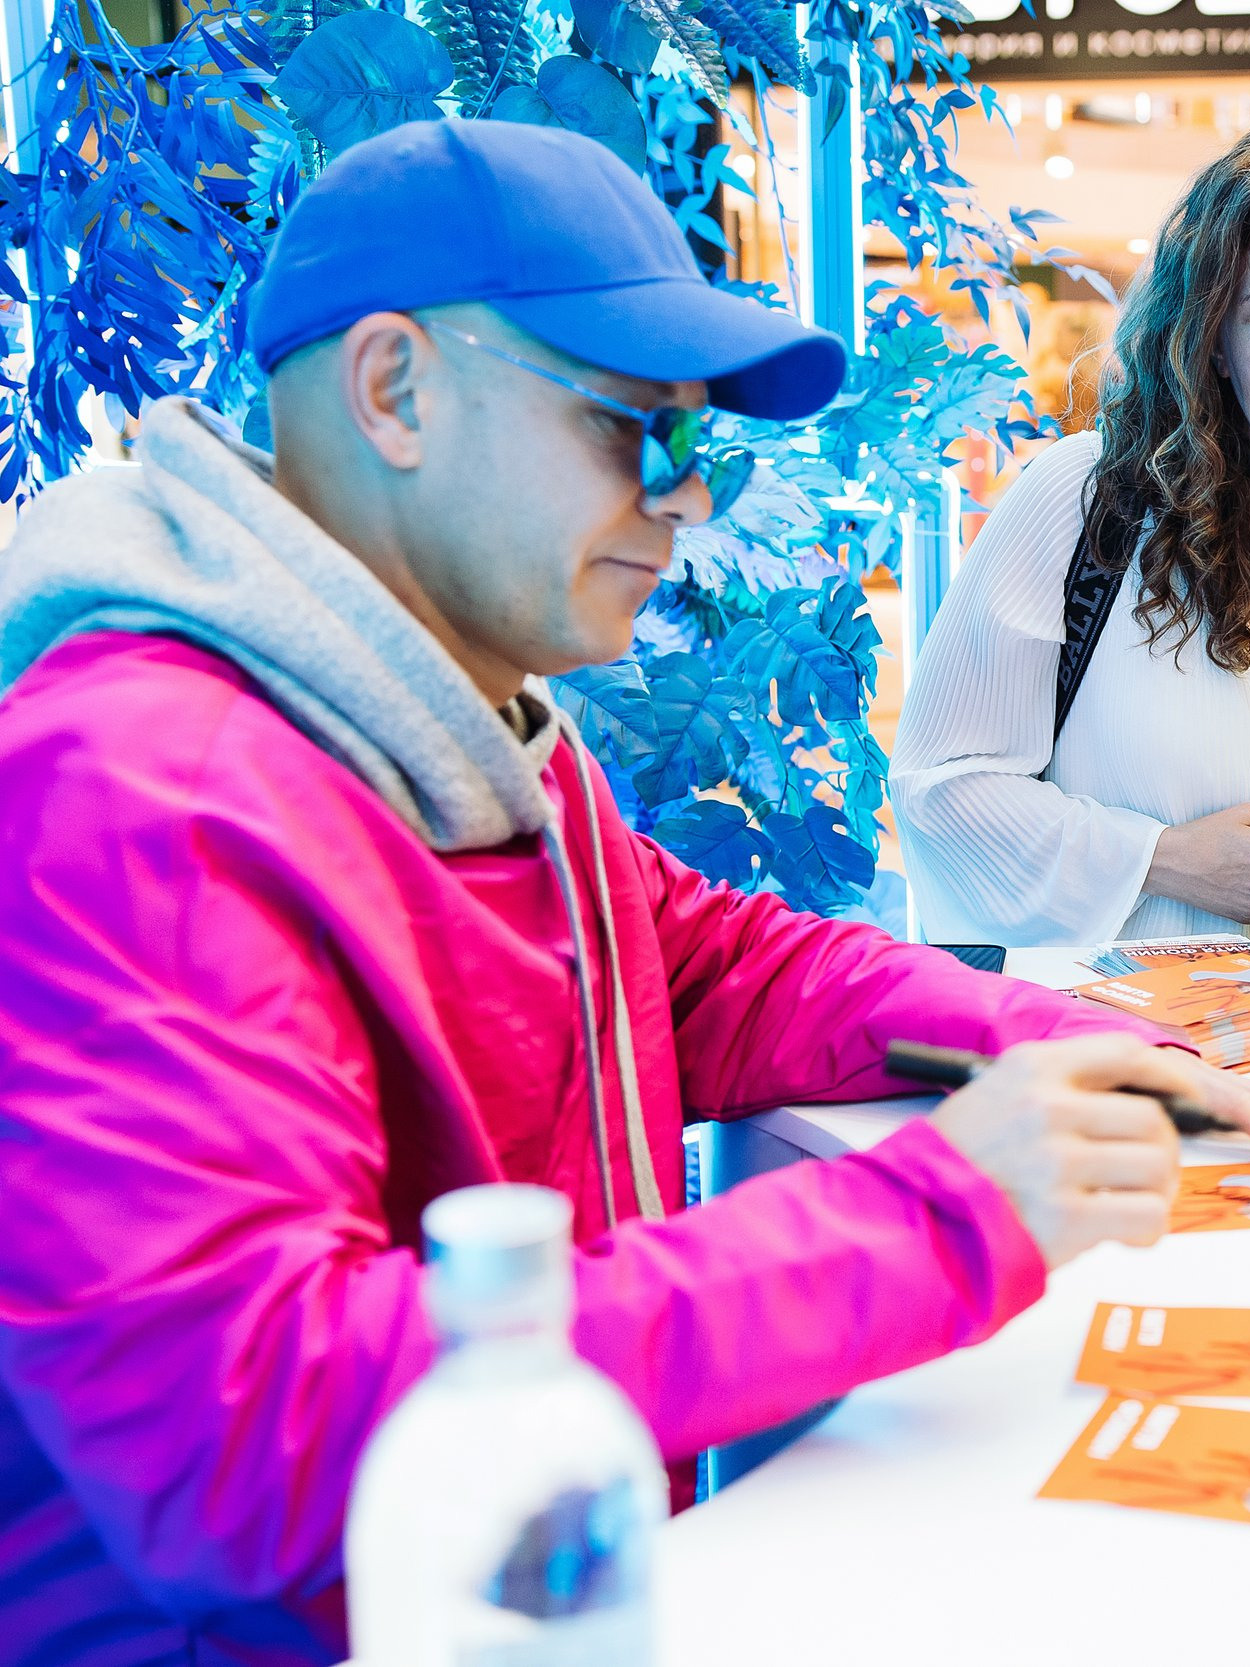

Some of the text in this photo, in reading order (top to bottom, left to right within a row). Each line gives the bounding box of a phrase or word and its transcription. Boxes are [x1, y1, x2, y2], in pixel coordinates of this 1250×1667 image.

[1052, 31, 1079, 57] и
[1058, 552, 1113, 692] BALLY
[1123, 948, 1198, 957] ФОМИН
